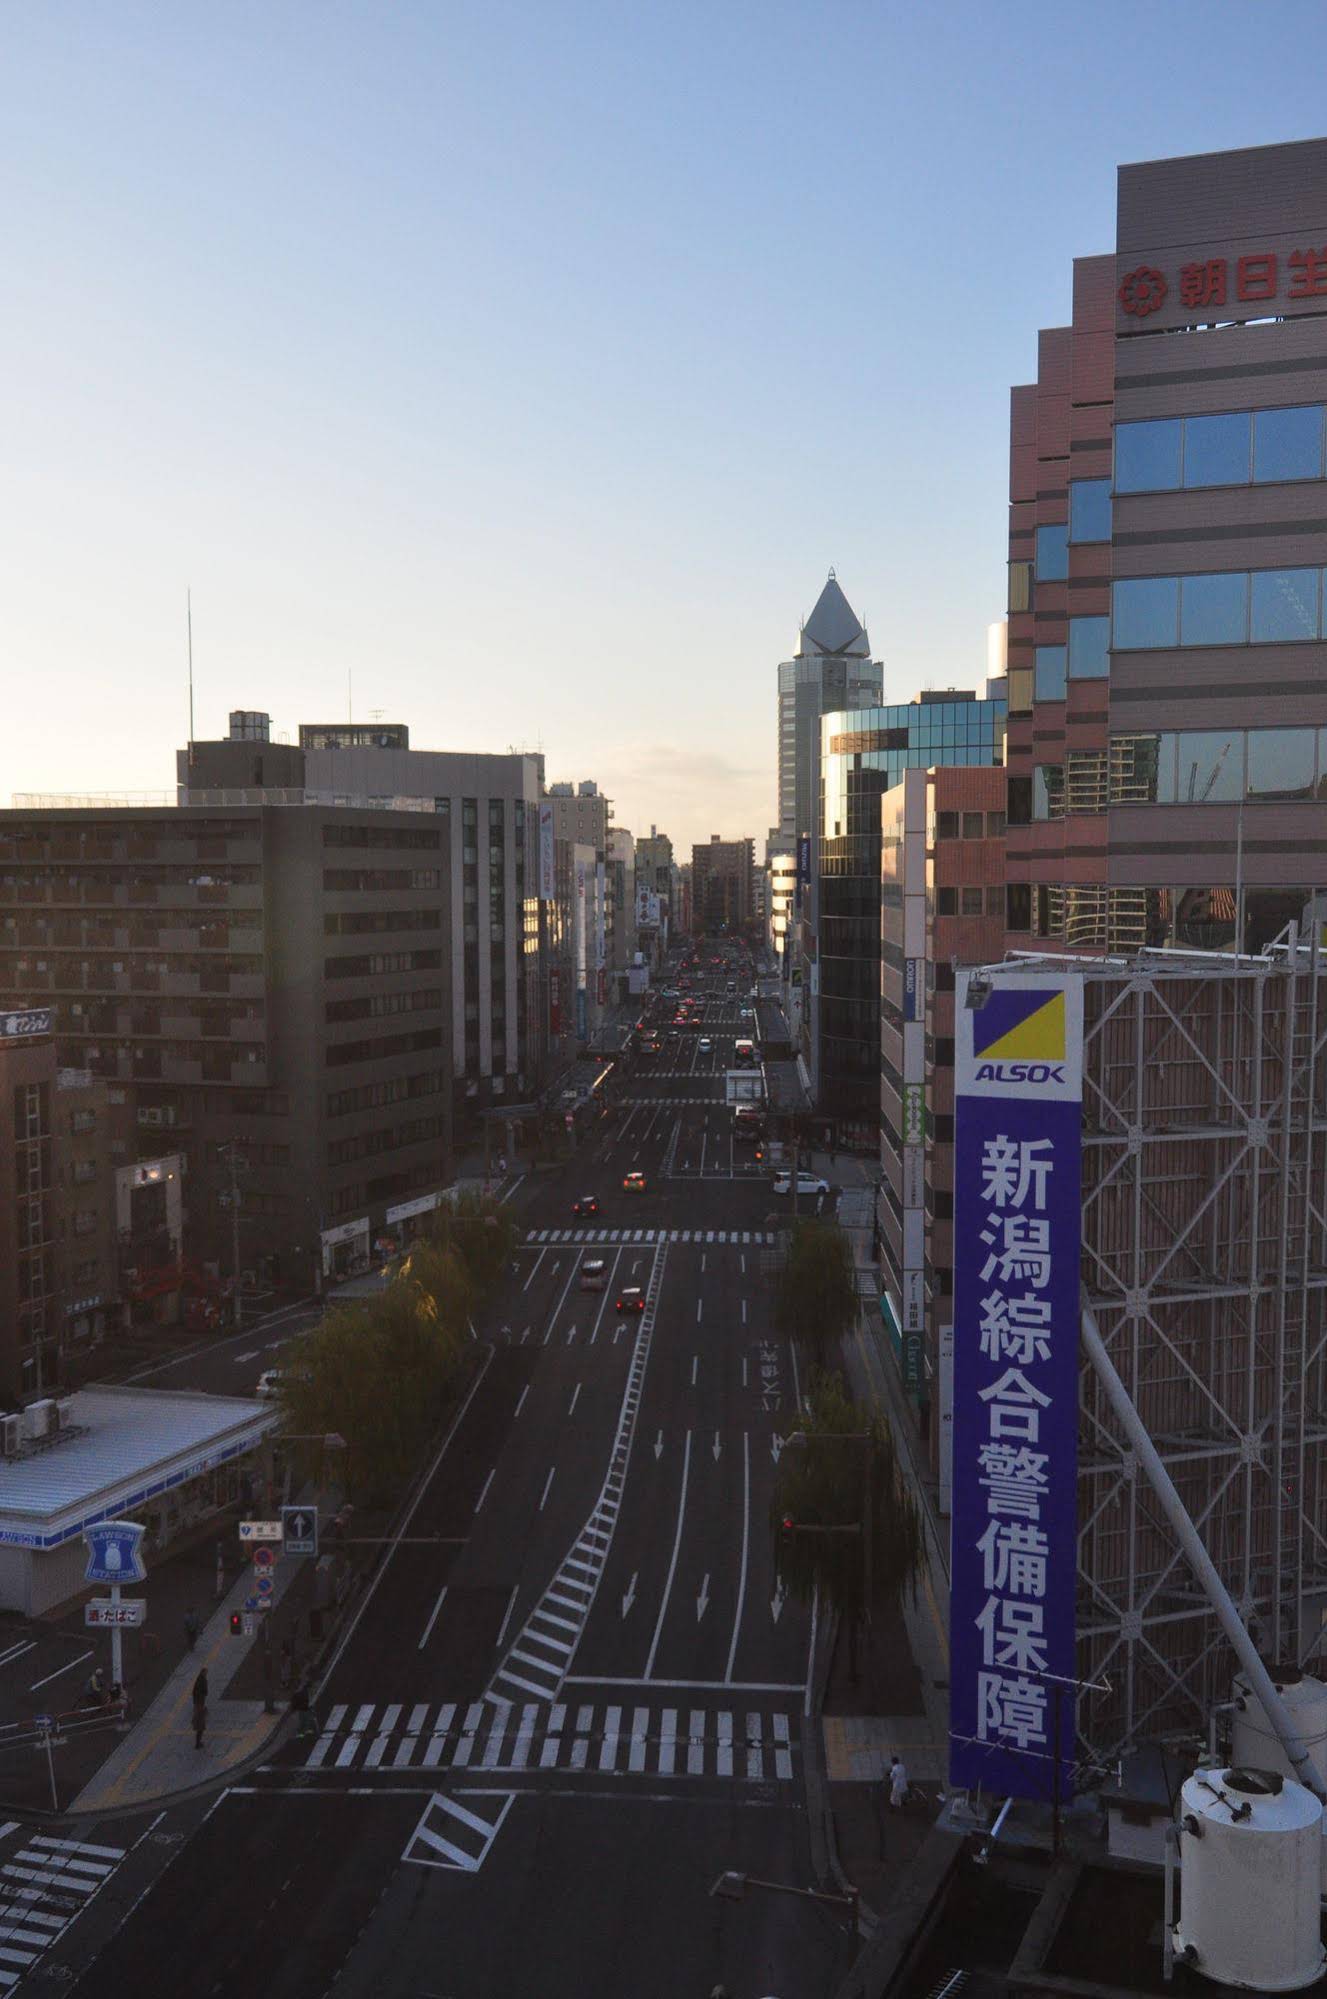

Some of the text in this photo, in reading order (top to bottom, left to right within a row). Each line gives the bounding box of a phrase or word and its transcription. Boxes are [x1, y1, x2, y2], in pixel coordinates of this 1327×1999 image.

[906, 960, 915, 993] omron
[975, 1064, 1065, 1084] ALSOK
[975, 1134, 1054, 1748] 新潟綜合警備保障
[93, 1530, 135, 1541] LAWSON
